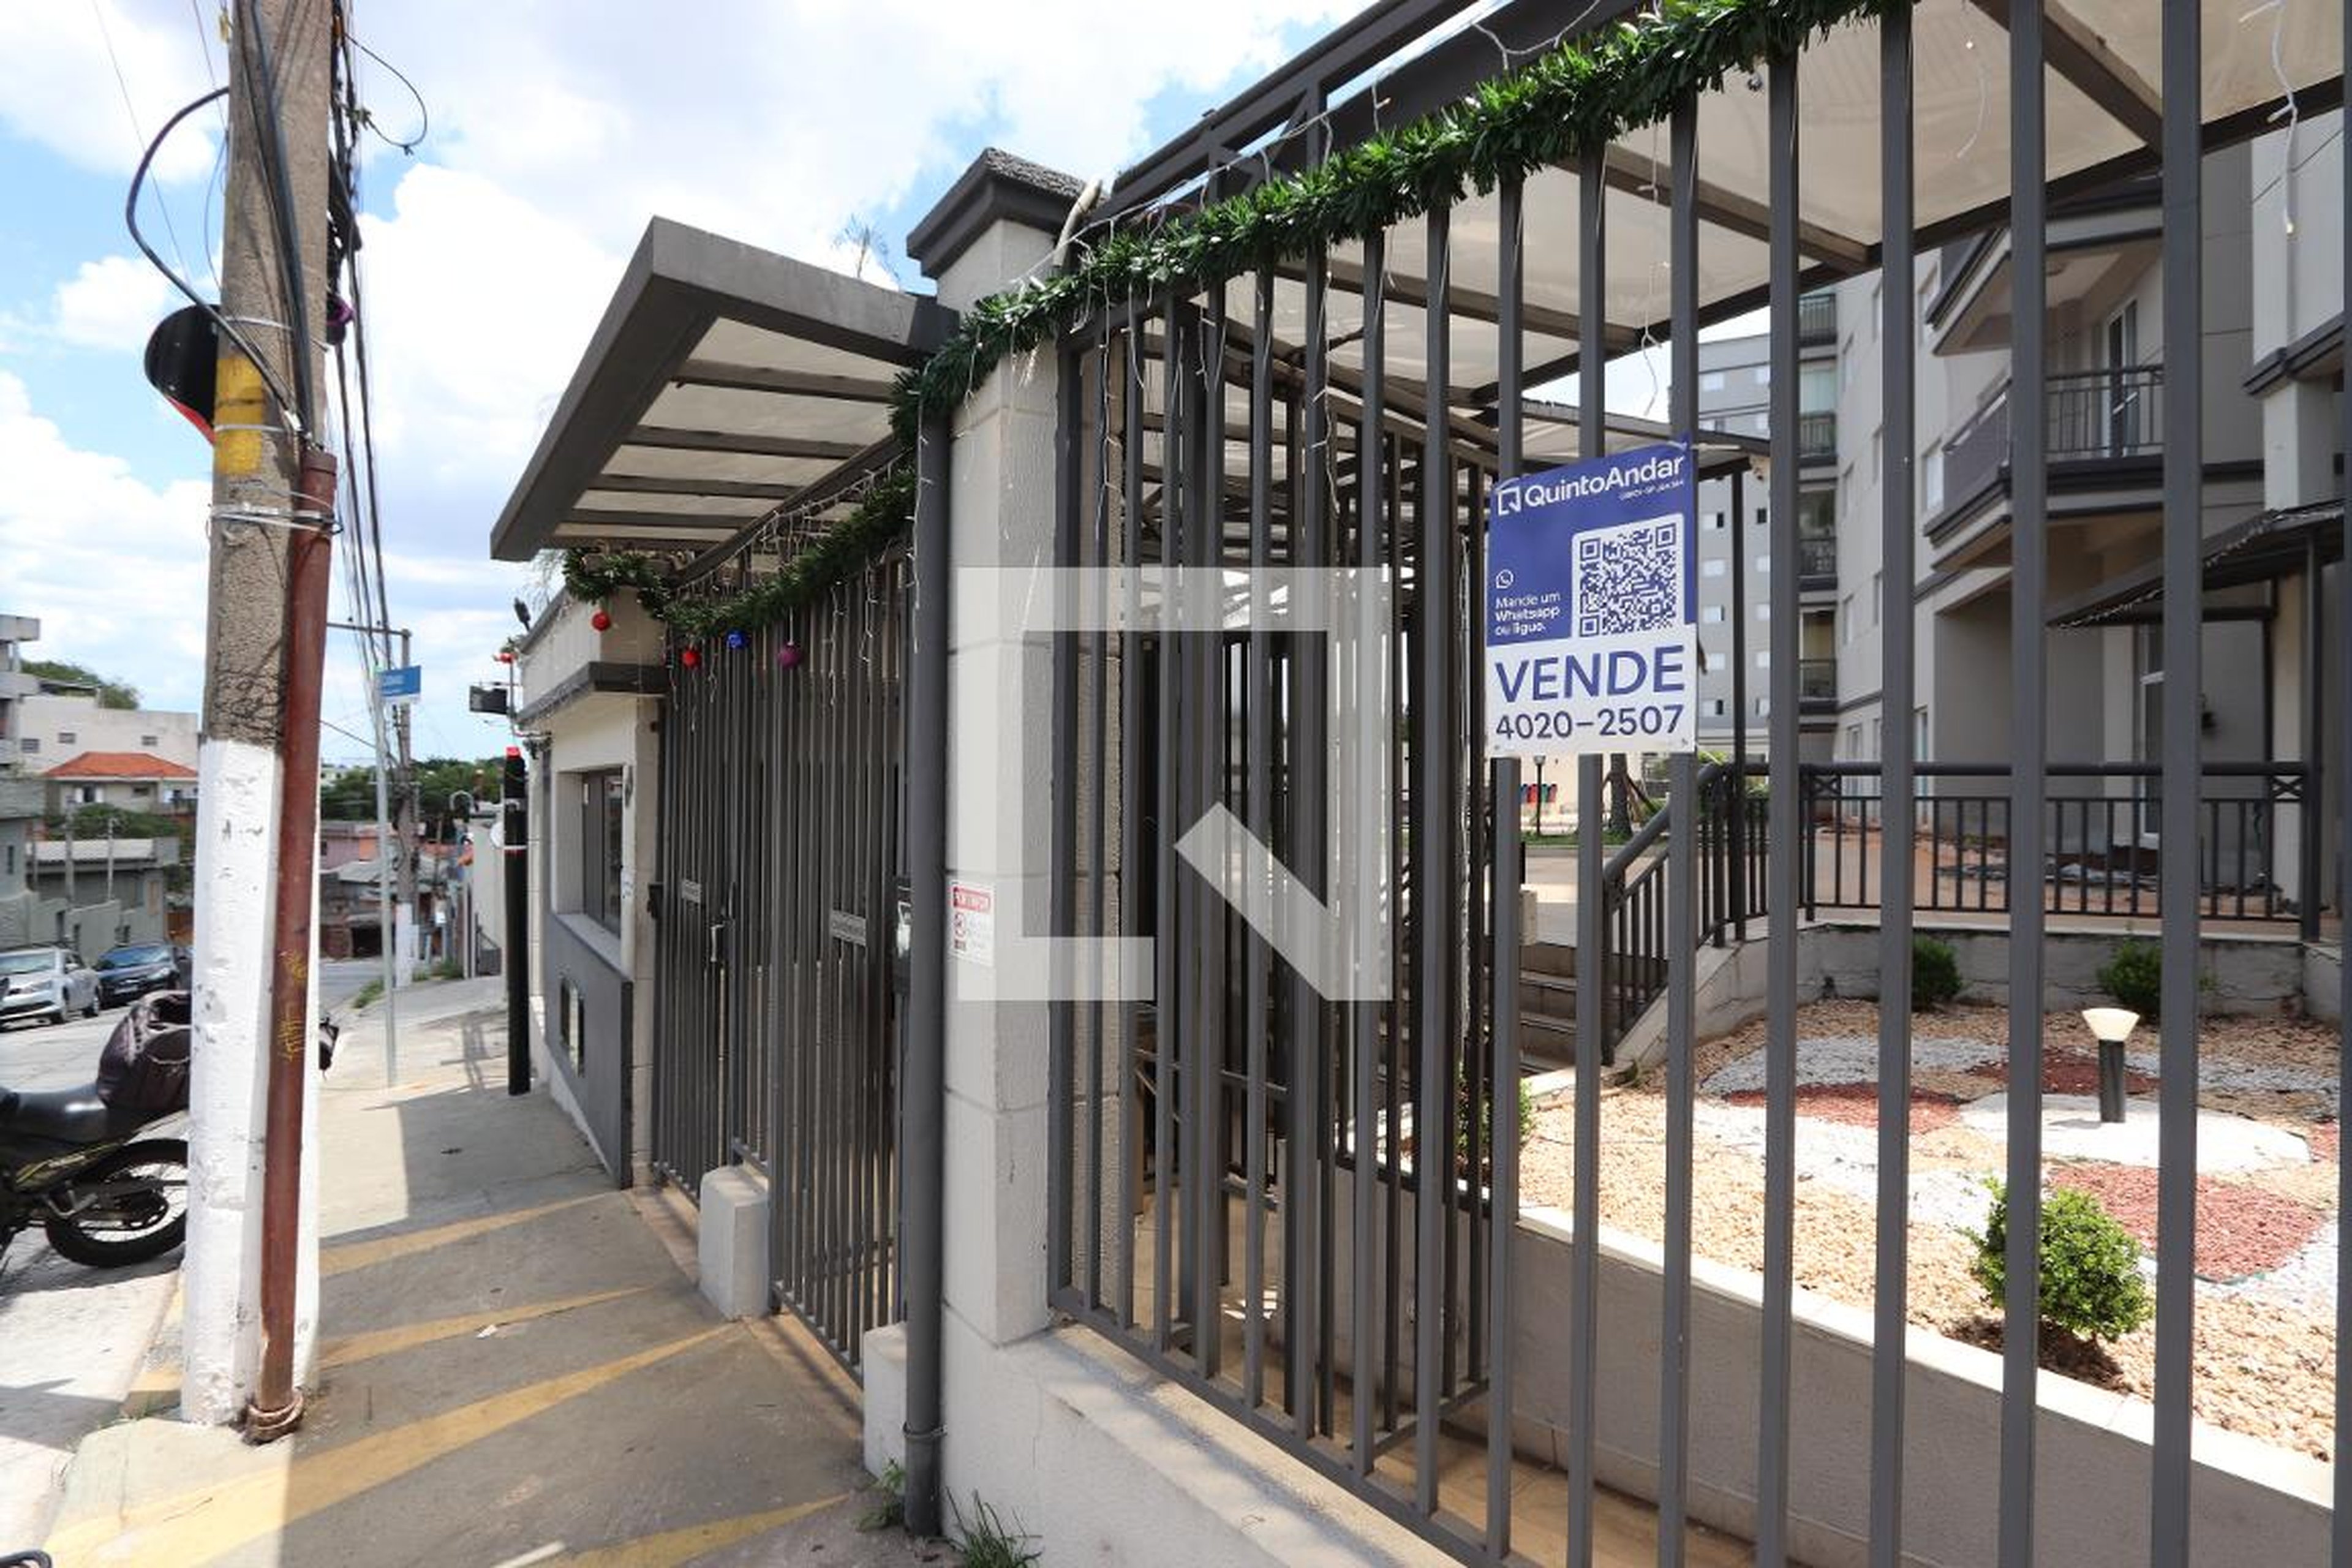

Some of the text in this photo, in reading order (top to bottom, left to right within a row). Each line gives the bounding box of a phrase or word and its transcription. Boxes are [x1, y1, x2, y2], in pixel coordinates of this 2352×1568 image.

[1524, 456, 1685, 507] QuintoAndar
[1495, 592, 1561, 609] Mande um
[1495, 606, 1561, 622] Whatsapp
[1494, 644, 1685, 703] VENDE
[1496, 704, 1684, 741] 4020-2507
